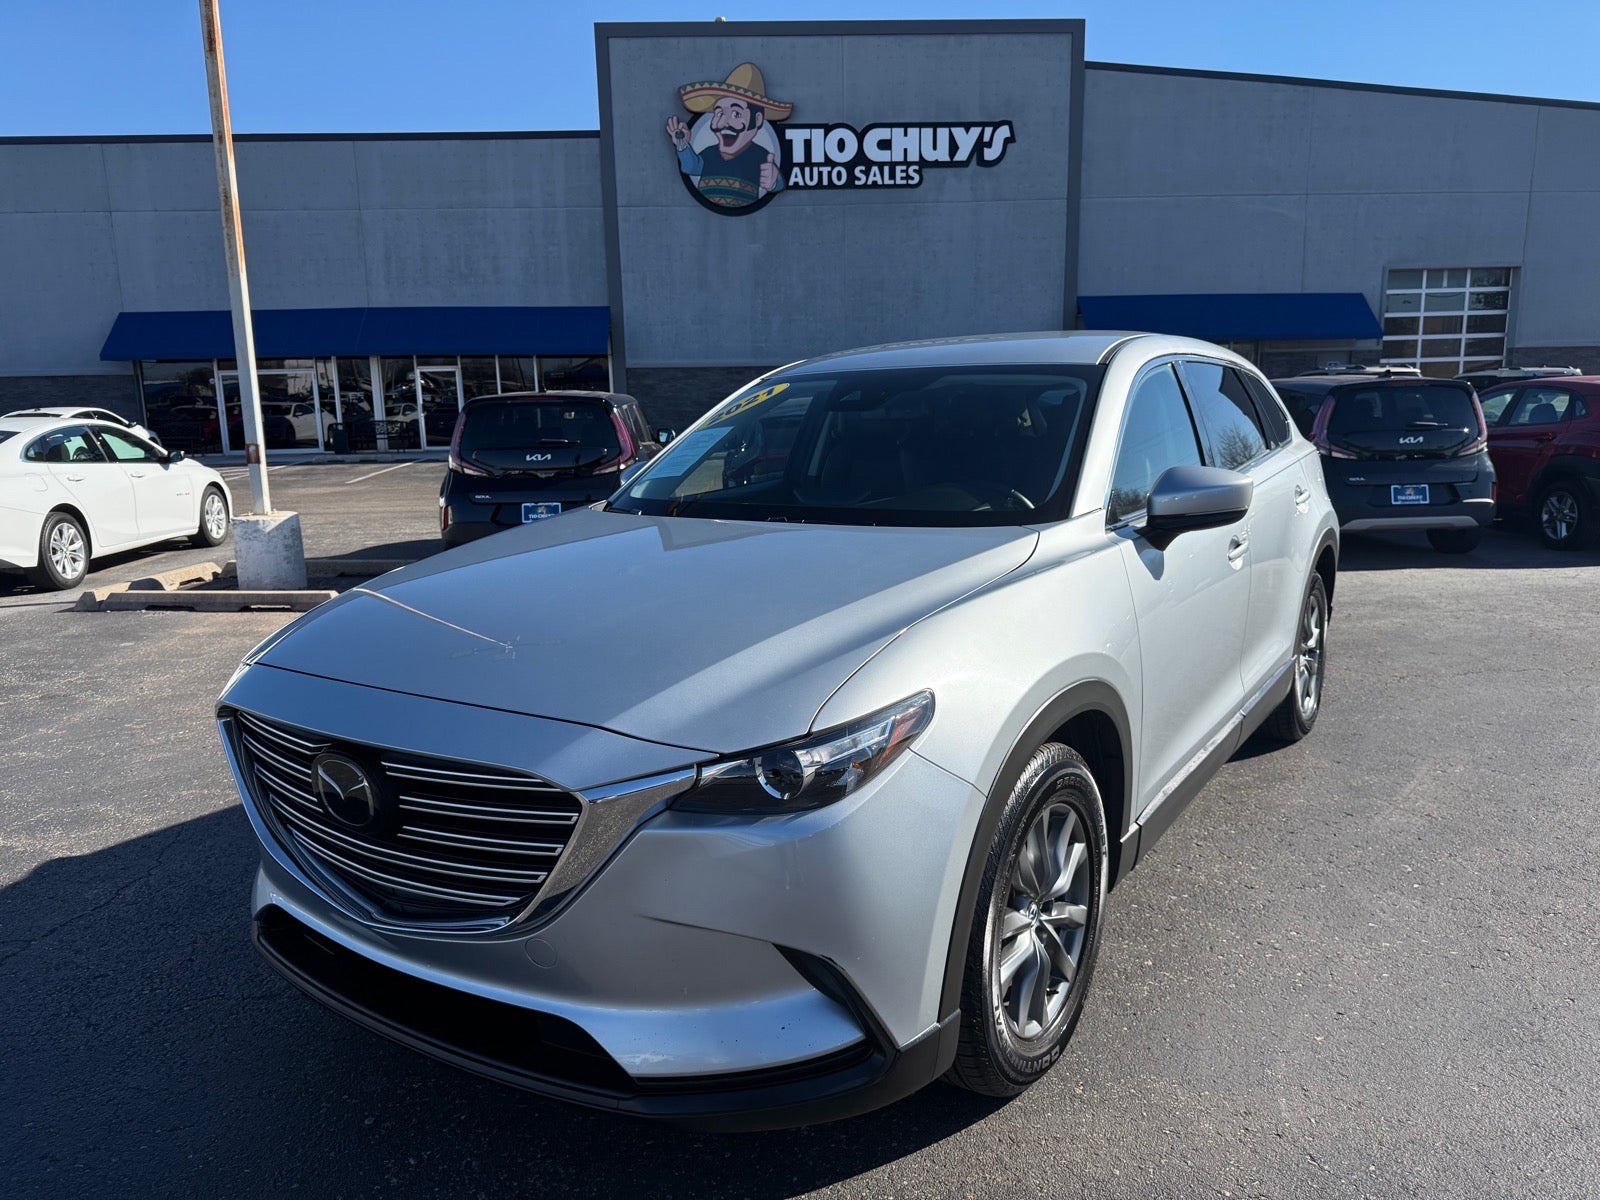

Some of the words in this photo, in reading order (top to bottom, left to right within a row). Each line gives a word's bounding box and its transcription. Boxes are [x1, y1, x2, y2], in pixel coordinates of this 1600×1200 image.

[785, 128, 858, 163] TIO
[863, 125, 1011, 162] CHUY'S
[788, 166, 847, 186] AUTO
[854, 166, 920, 185] SALES
